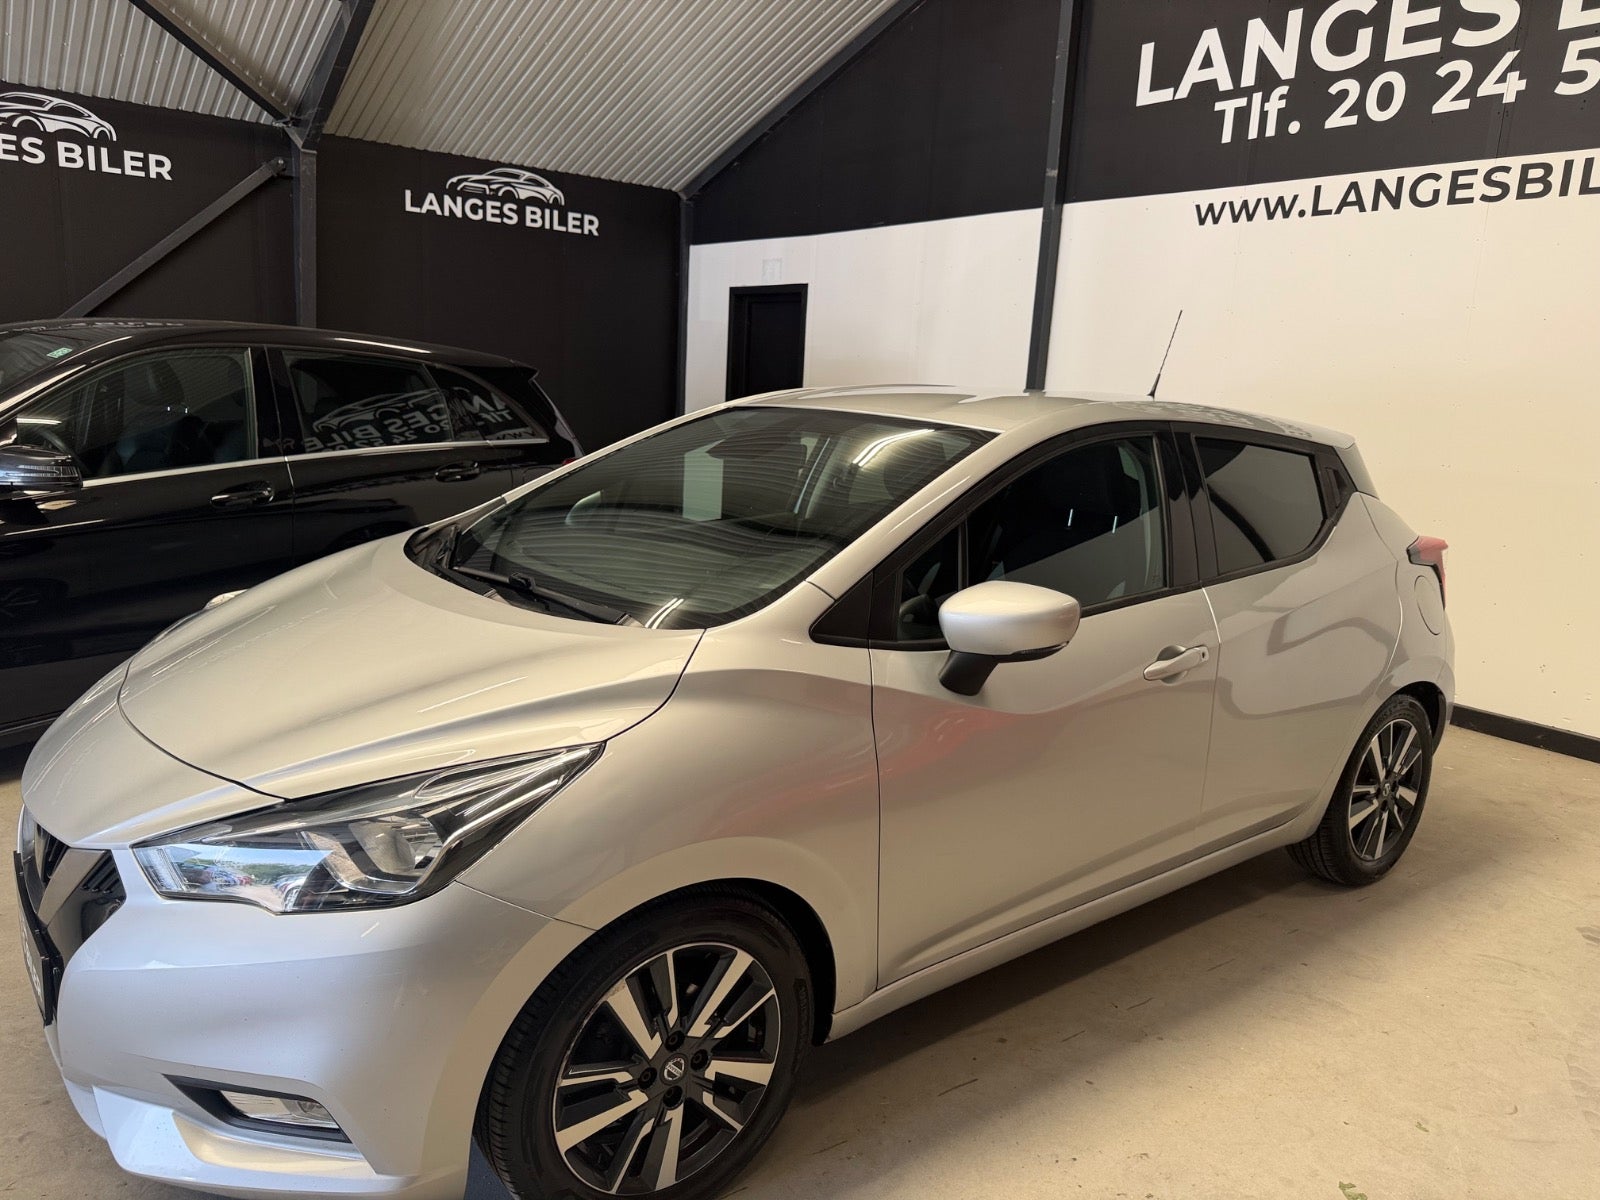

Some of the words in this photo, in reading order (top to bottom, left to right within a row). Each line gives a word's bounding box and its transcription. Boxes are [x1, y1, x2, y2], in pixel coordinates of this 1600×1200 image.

[1136, 0, 1520, 106] LANGES
[1213, 86, 1301, 144] Tlf.
[1325, 71, 1405, 129] 20
[1432, 49, 1526, 115] 24
[57, 141, 172, 181] BILER
[405, 189, 518, 225] LANGES
[525, 206, 599, 236] BILER
